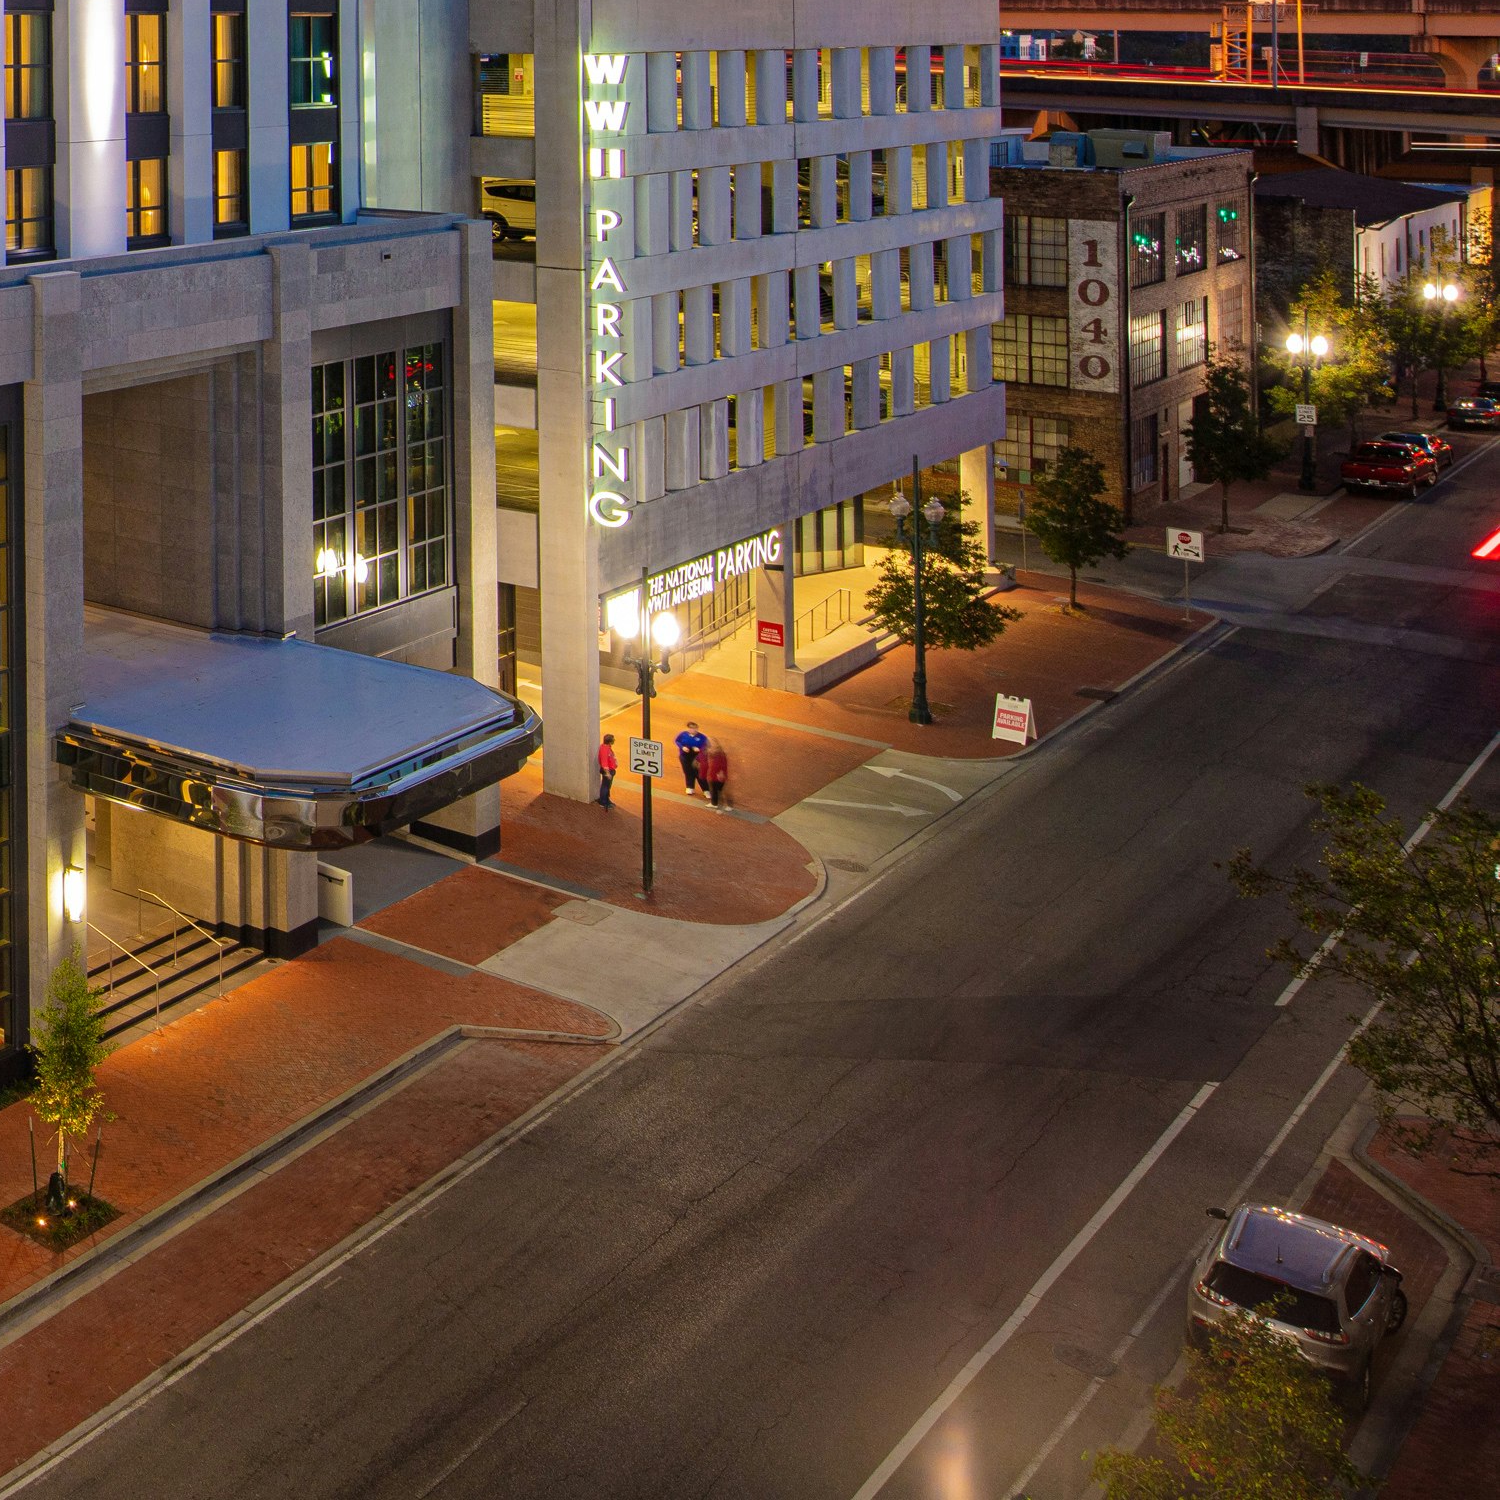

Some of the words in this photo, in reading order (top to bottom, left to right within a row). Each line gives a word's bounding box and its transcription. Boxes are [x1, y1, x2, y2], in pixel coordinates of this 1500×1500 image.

[584, 54, 630, 178] WWII
[1077, 239, 1111, 380] 1040
[589, 209, 632, 528] PARKING
[1299, 414, 1314, 422] 25
[717, 529, 781, 583] PARKING
[665, 555, 714, 590] NATIONAL
[672, 574, 714, 607] MUSEUM
[997, 717, 1025, 729] AVAILABLE
[1000, 712, 1024, 722] PARKING
[633, 741, 659, 751] SPEED
[636, 749, 656, 757] LIMIT
[633, 758, 659, 774] 25
